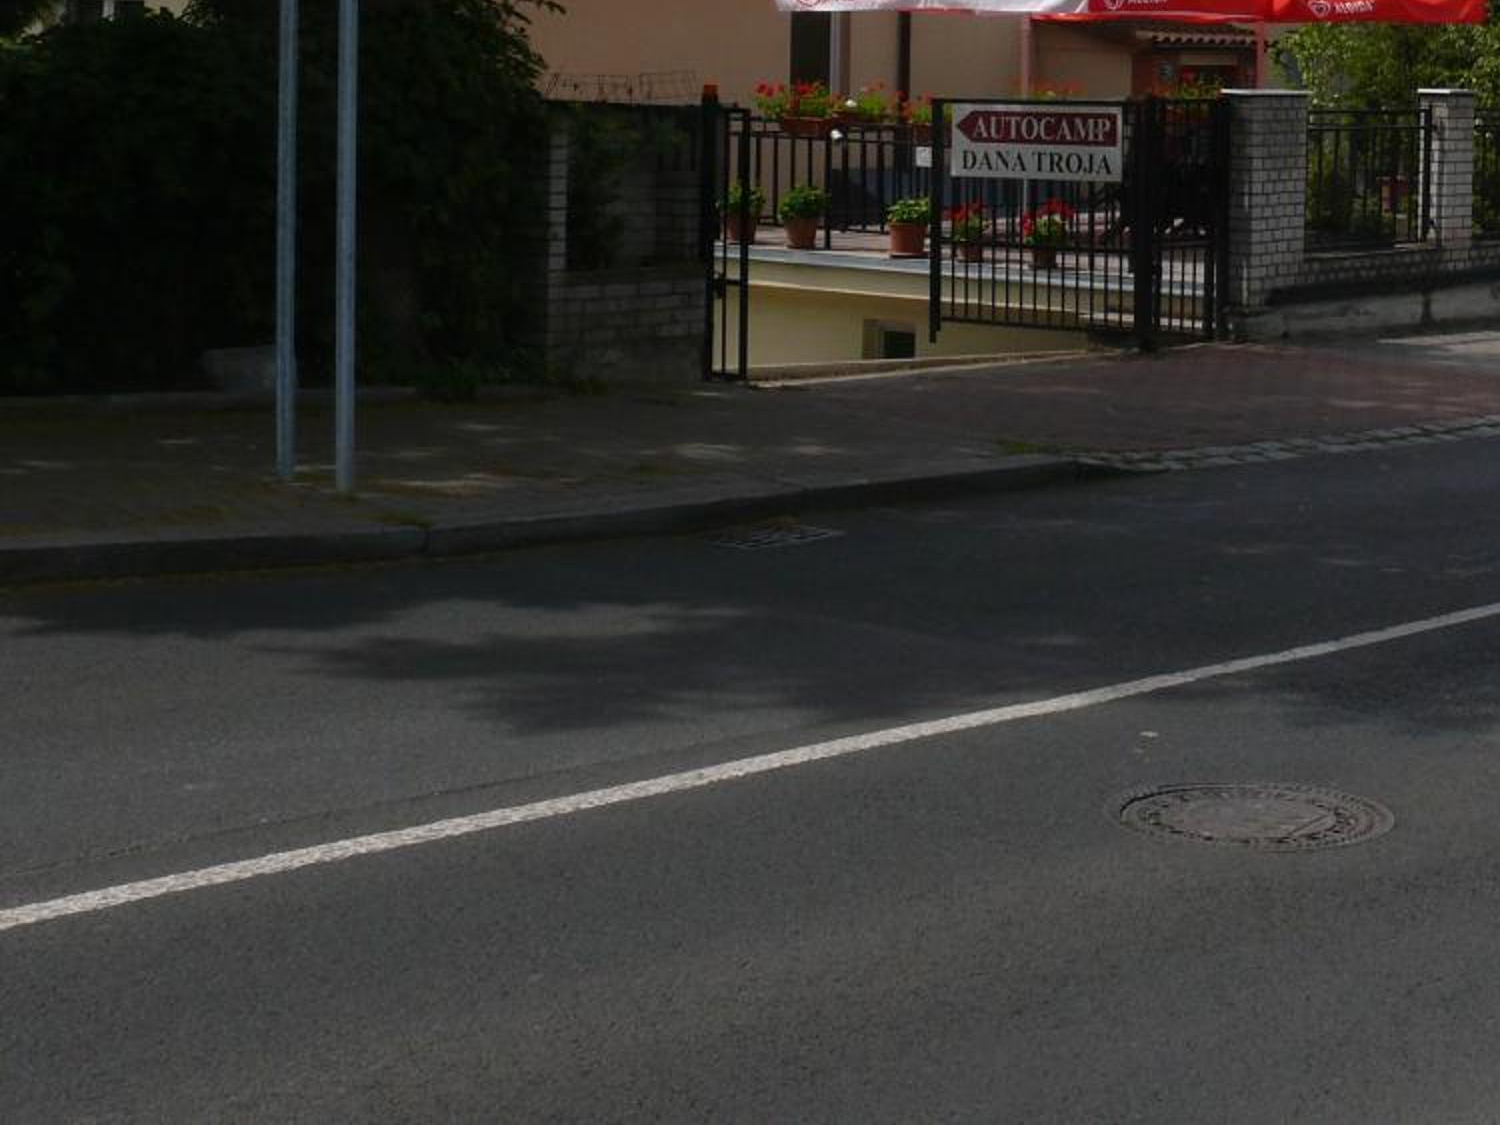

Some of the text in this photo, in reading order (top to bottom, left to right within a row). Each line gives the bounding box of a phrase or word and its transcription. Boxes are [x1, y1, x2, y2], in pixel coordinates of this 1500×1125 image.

[973, 116, 1110, 141] AUTOCAMP
[962, 149, 1111, 175] DANA TROJA
